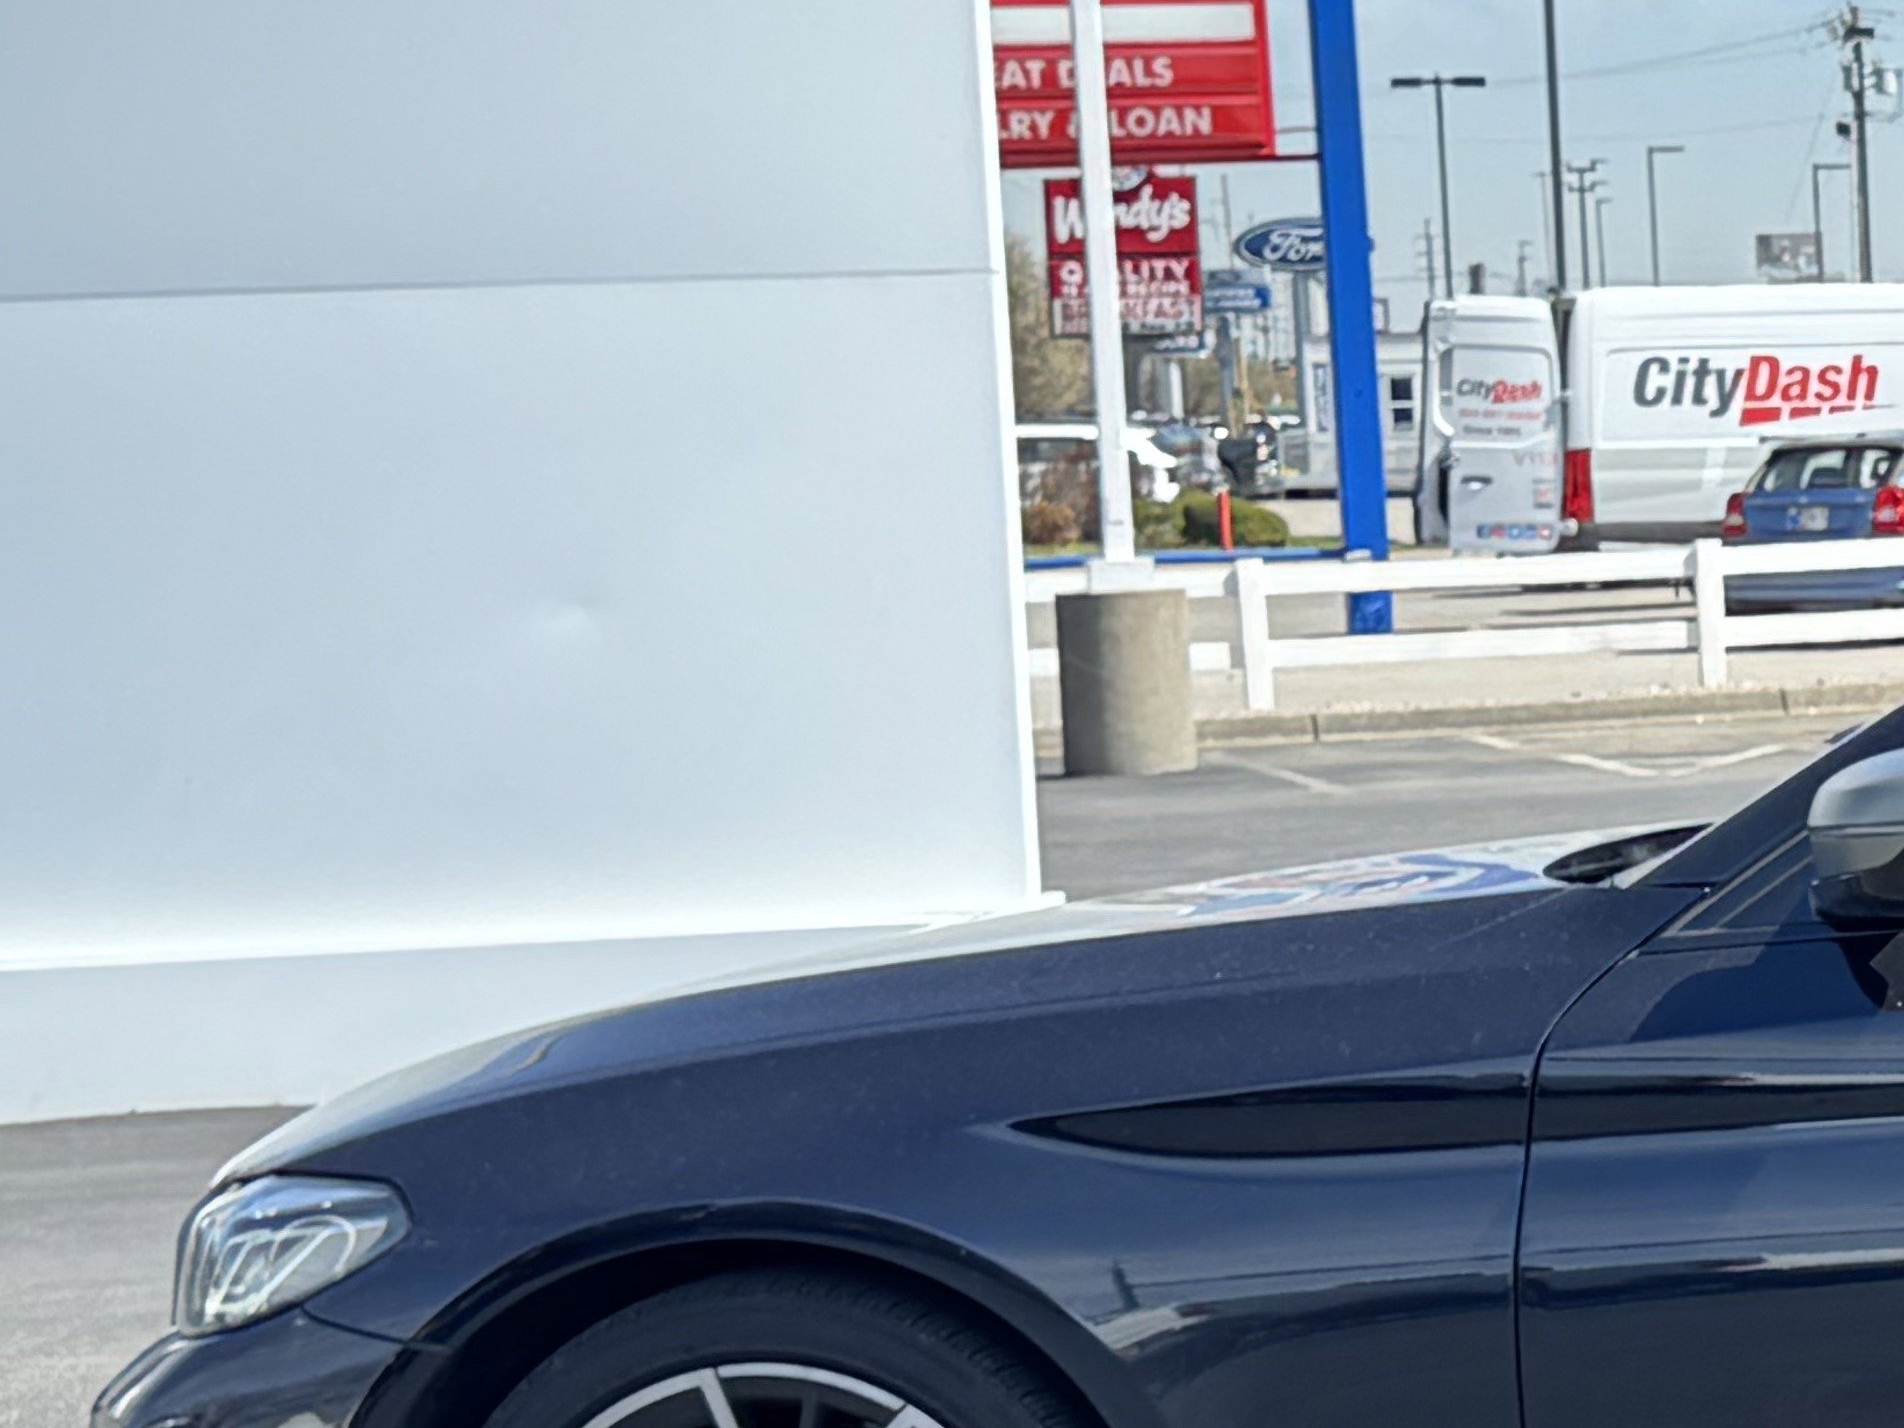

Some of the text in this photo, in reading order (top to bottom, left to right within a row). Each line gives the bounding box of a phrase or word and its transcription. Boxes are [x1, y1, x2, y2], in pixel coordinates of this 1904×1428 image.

[1057, 56, 1173, 90] DALS
[1109, 106, 1212, 138] LOAN
[1053, 184, 1191, 244] Wndy's
[1262, 227, 1323, 261] For
[1059, 259, 1190, 285] QLITY
[1633, 355, 1879, 418] CityDash
